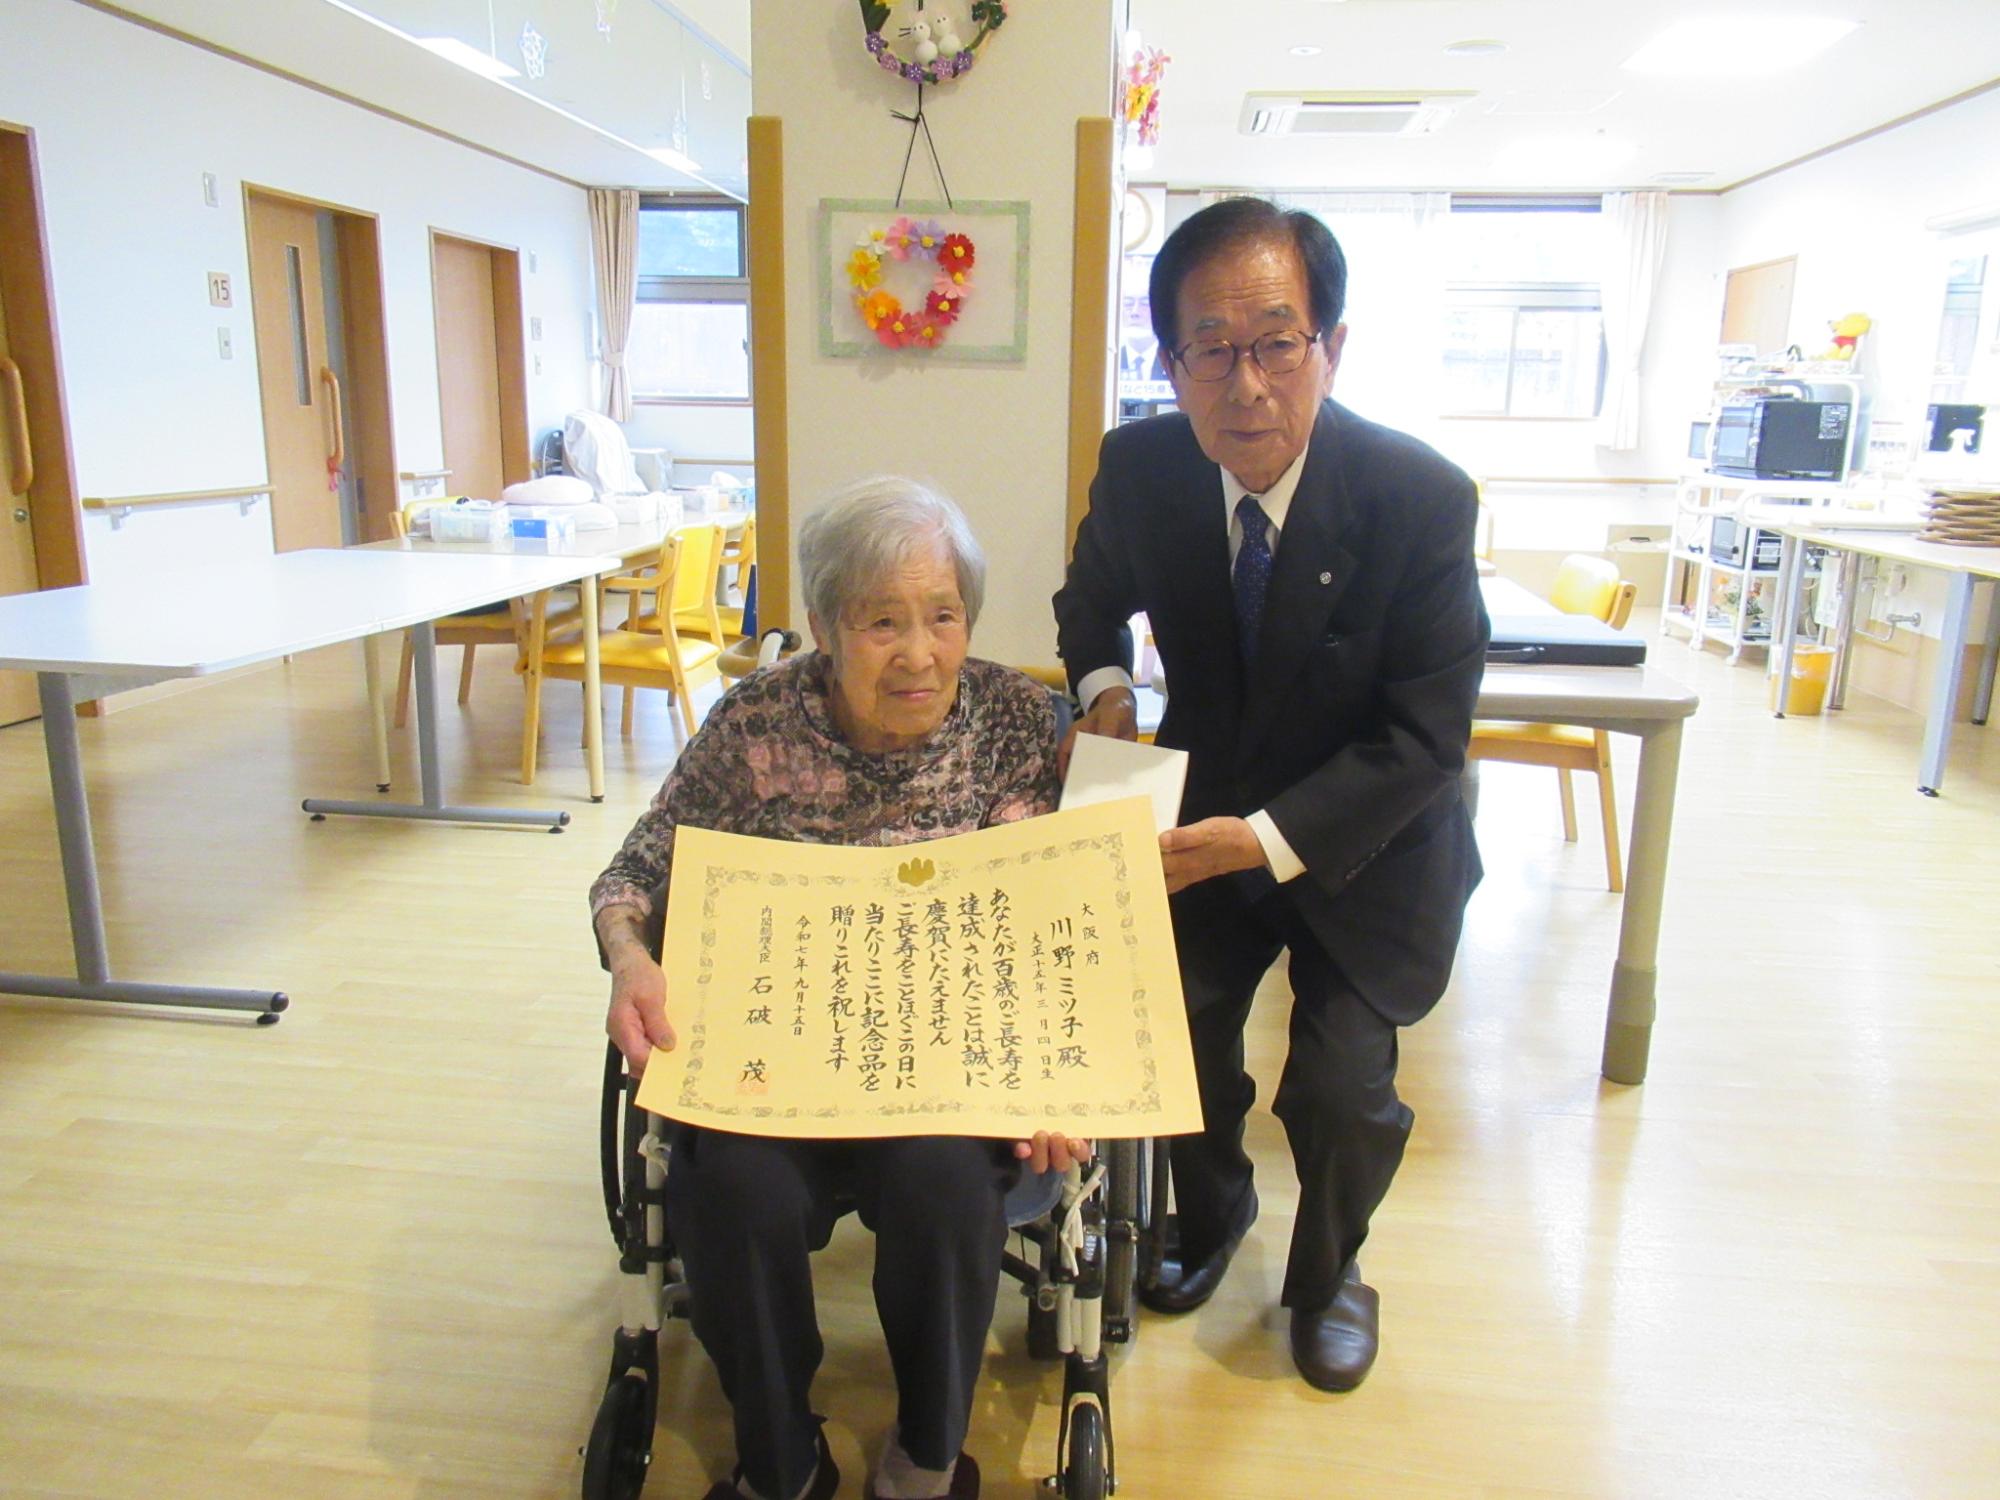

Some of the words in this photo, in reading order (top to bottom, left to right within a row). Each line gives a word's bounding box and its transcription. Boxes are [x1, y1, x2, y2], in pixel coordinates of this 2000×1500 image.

[213, 279, 230, 301] 15
[790, 915, 812, 1036] 令和七年九月十五日
[825, 904, 855, 1073] 贈りこれを祝します
[858, 902, 889, 1091] 当たりここに記念品を
[893, 902, 920, 1090] ご長寿をことほぐこの日に
[922, 898, 952, 1047] 慶賀にたえません
[957, 892, 994, 1088] 達成されたことは誠に
[990, 888, 1023, 1090] あなたが百歳のご長寿を
[1050, 917, 1091, 1069] 川野ミツ子殿
[1081, 902, 1099, 967] 大阪府
